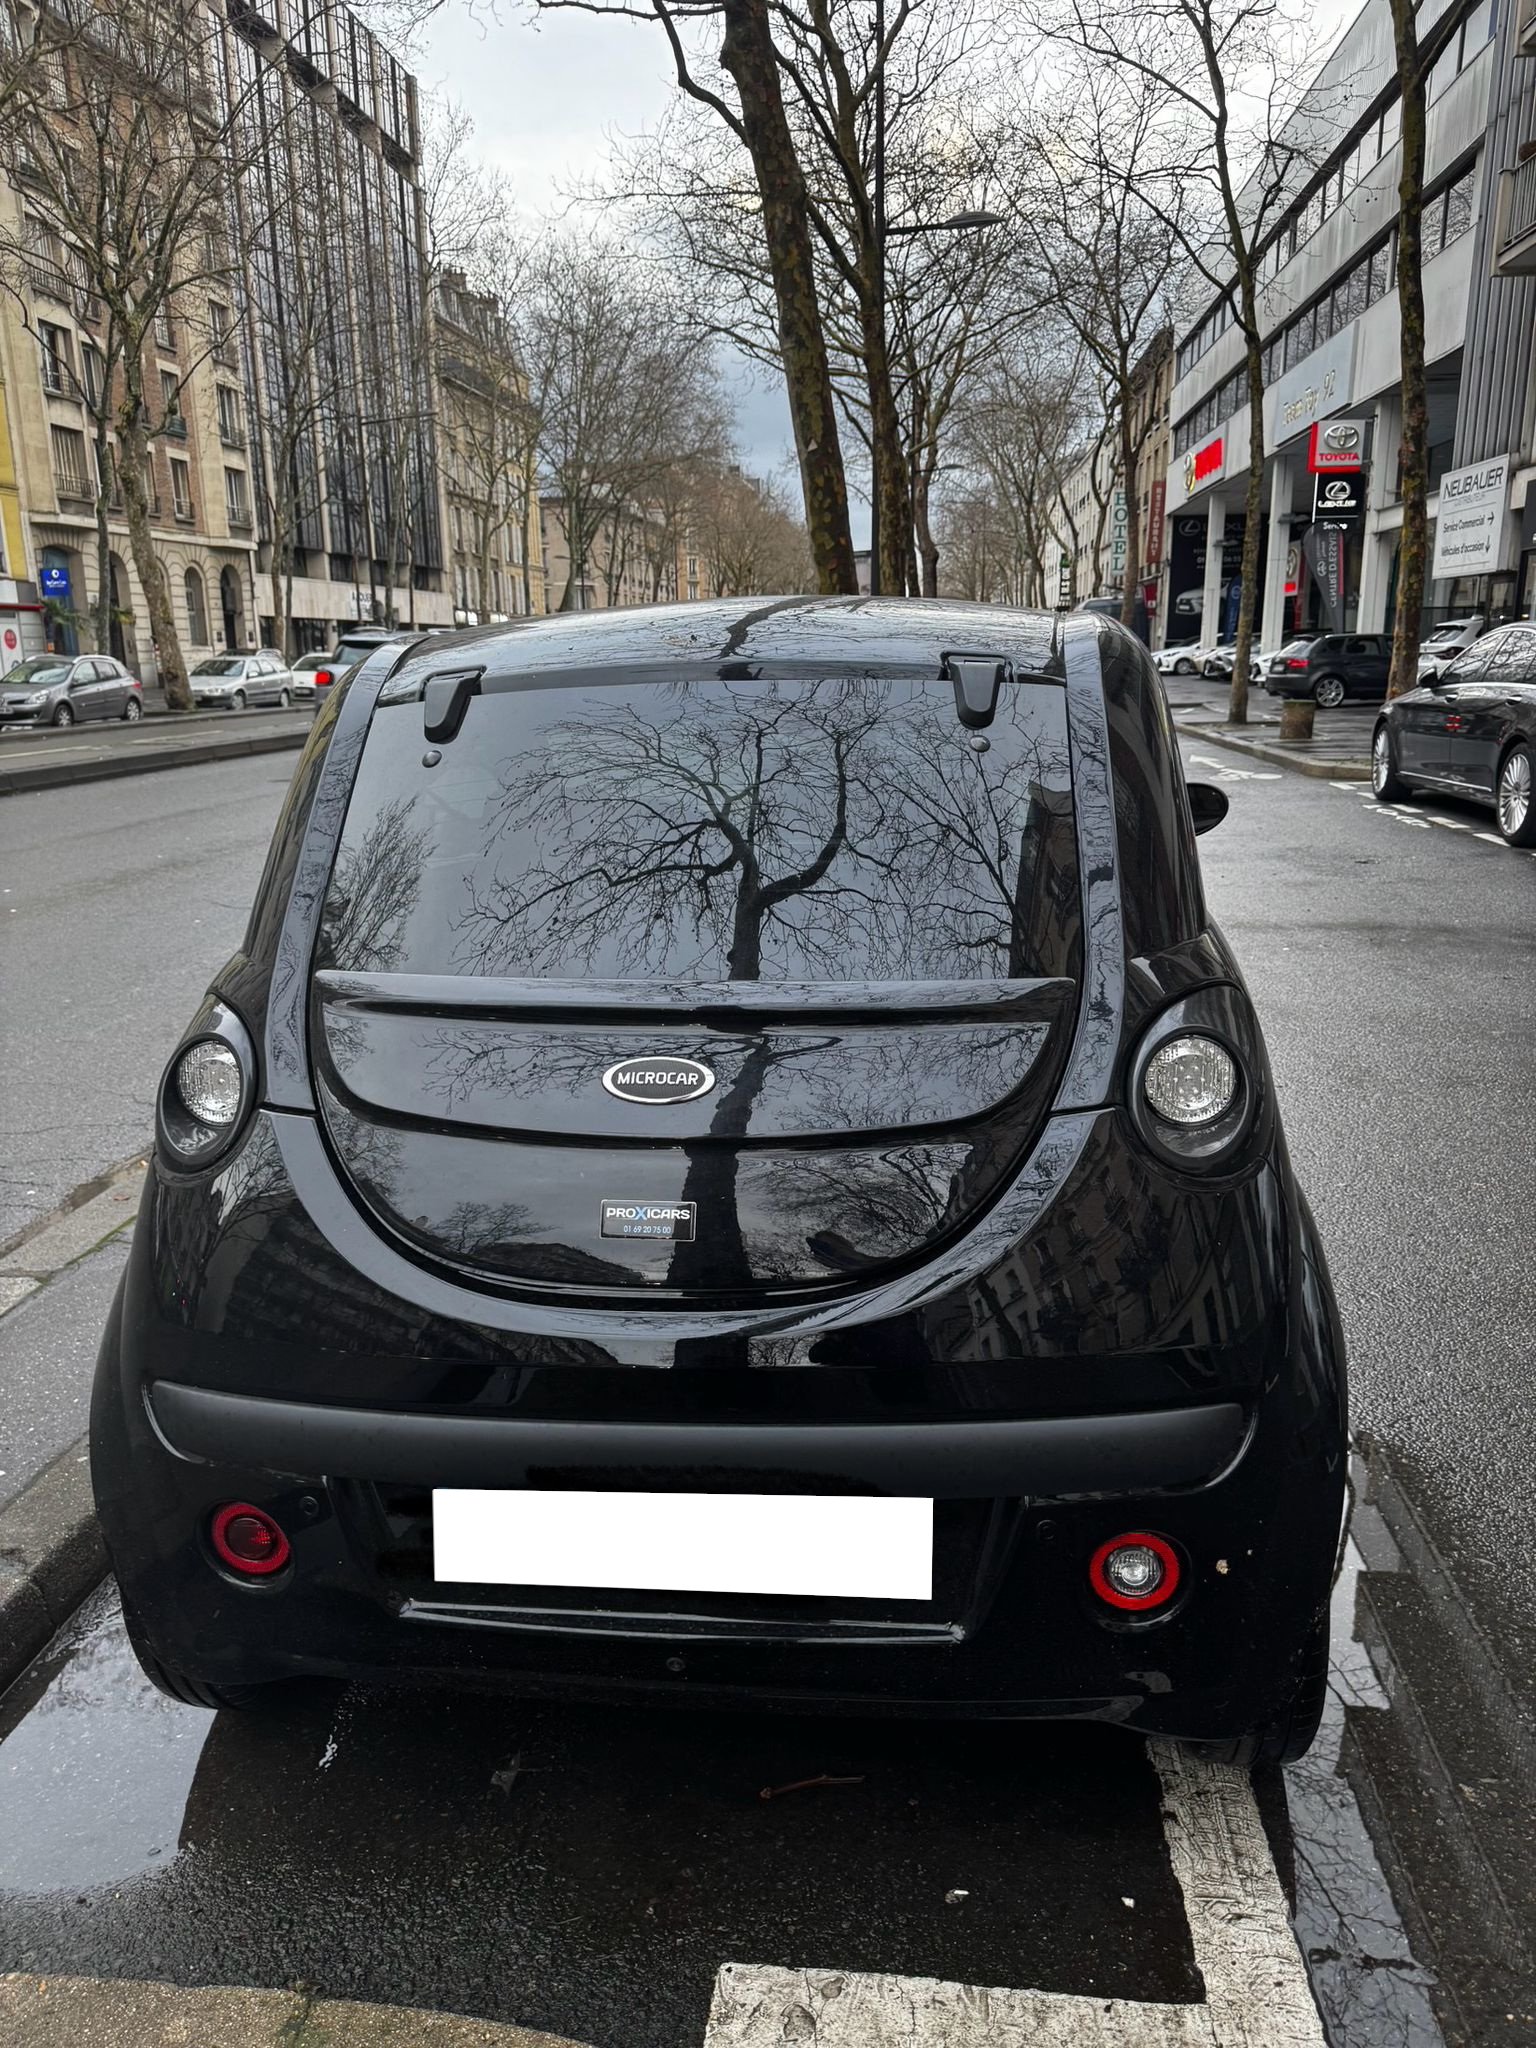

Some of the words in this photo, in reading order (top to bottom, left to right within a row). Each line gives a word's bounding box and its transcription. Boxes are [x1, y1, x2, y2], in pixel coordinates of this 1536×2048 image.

[1324, 369, 1336, 401] 92
[1319, 452, 1360, 462] TOYOTA
[1443, 466, 1504, 500] NEUBAUER
[1114, 491, 1128, 571] HOTEL
[617, 1071, 699, 1086] MICROCAR
[606, 1206, 691, 1221] PROXICARS
[623, 1225, 631, 1233] 01
[652, 1226, 661, 1234] 75
[662, 1226, 671, 1234] 00
